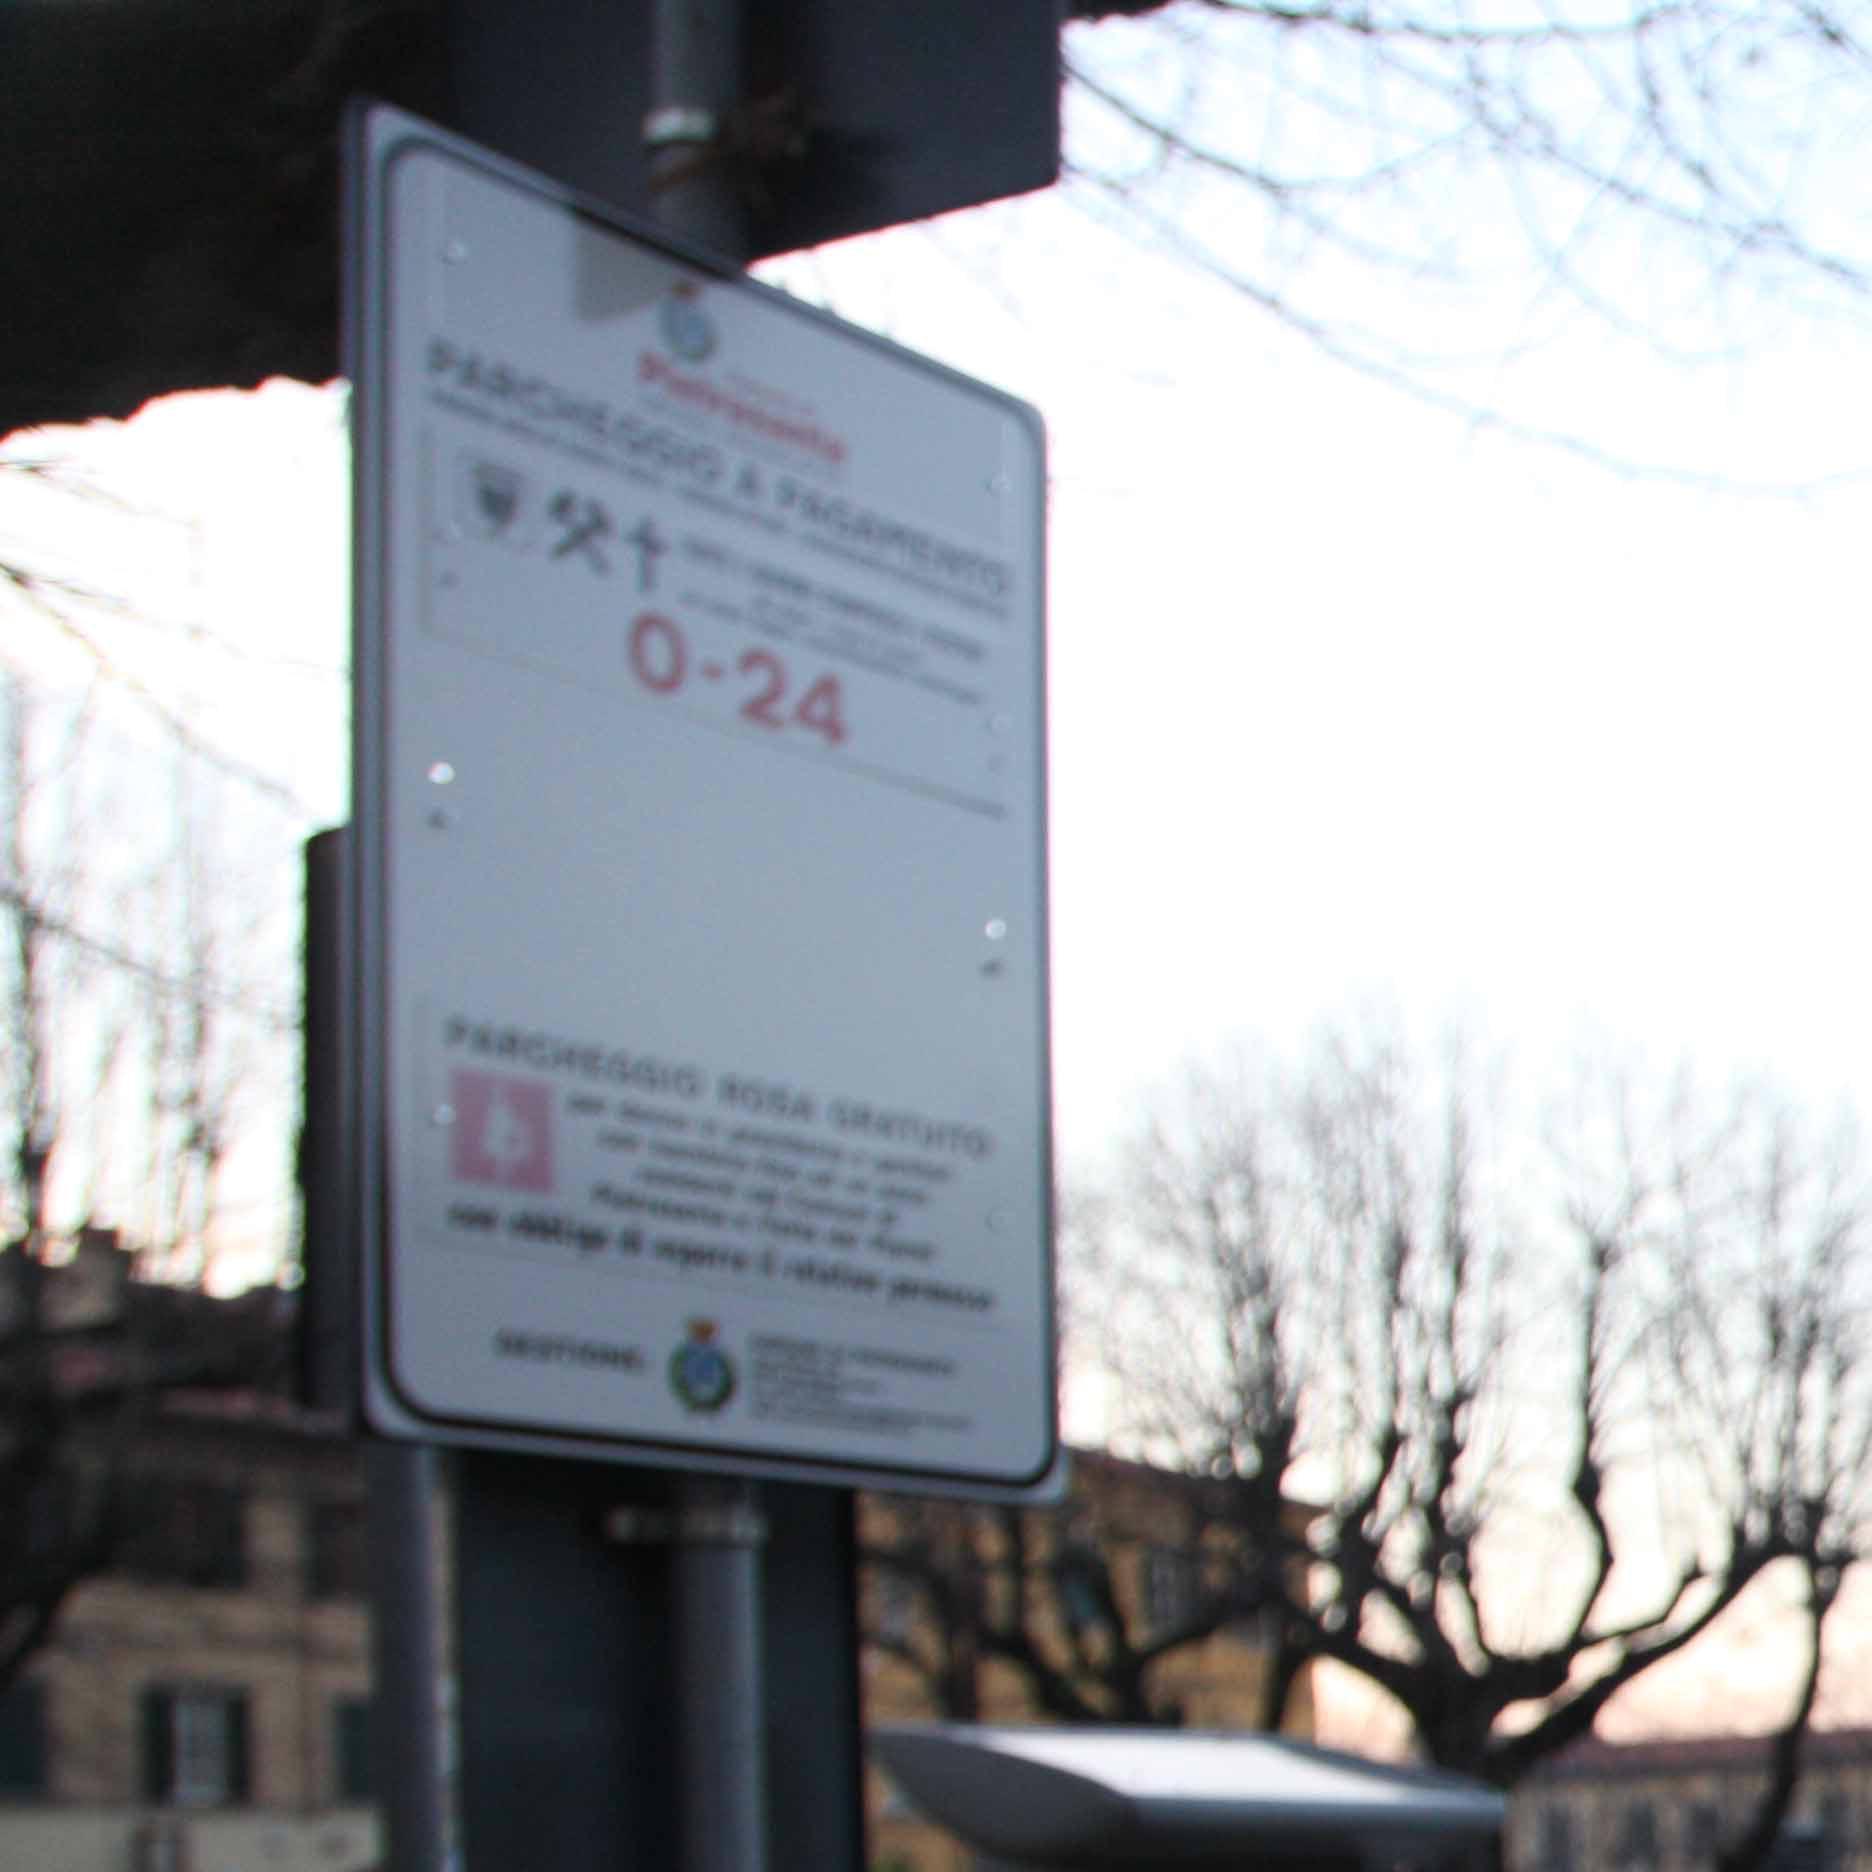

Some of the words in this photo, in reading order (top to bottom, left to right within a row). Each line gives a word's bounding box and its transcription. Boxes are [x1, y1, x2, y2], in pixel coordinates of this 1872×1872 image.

[427, 337, 725, 486] PARCHEGGIO
[736, 464, 760, 501] A
[774, 475, 1012, 599] PAGAMENTO
[627, 610, 849, 749] 0-24
[446, 1013, 703, 1099] PARCHEGGIO
[717, 1072, 817, 1121] ROSA
[828, 1095, 993, 1160] GRATUITO
